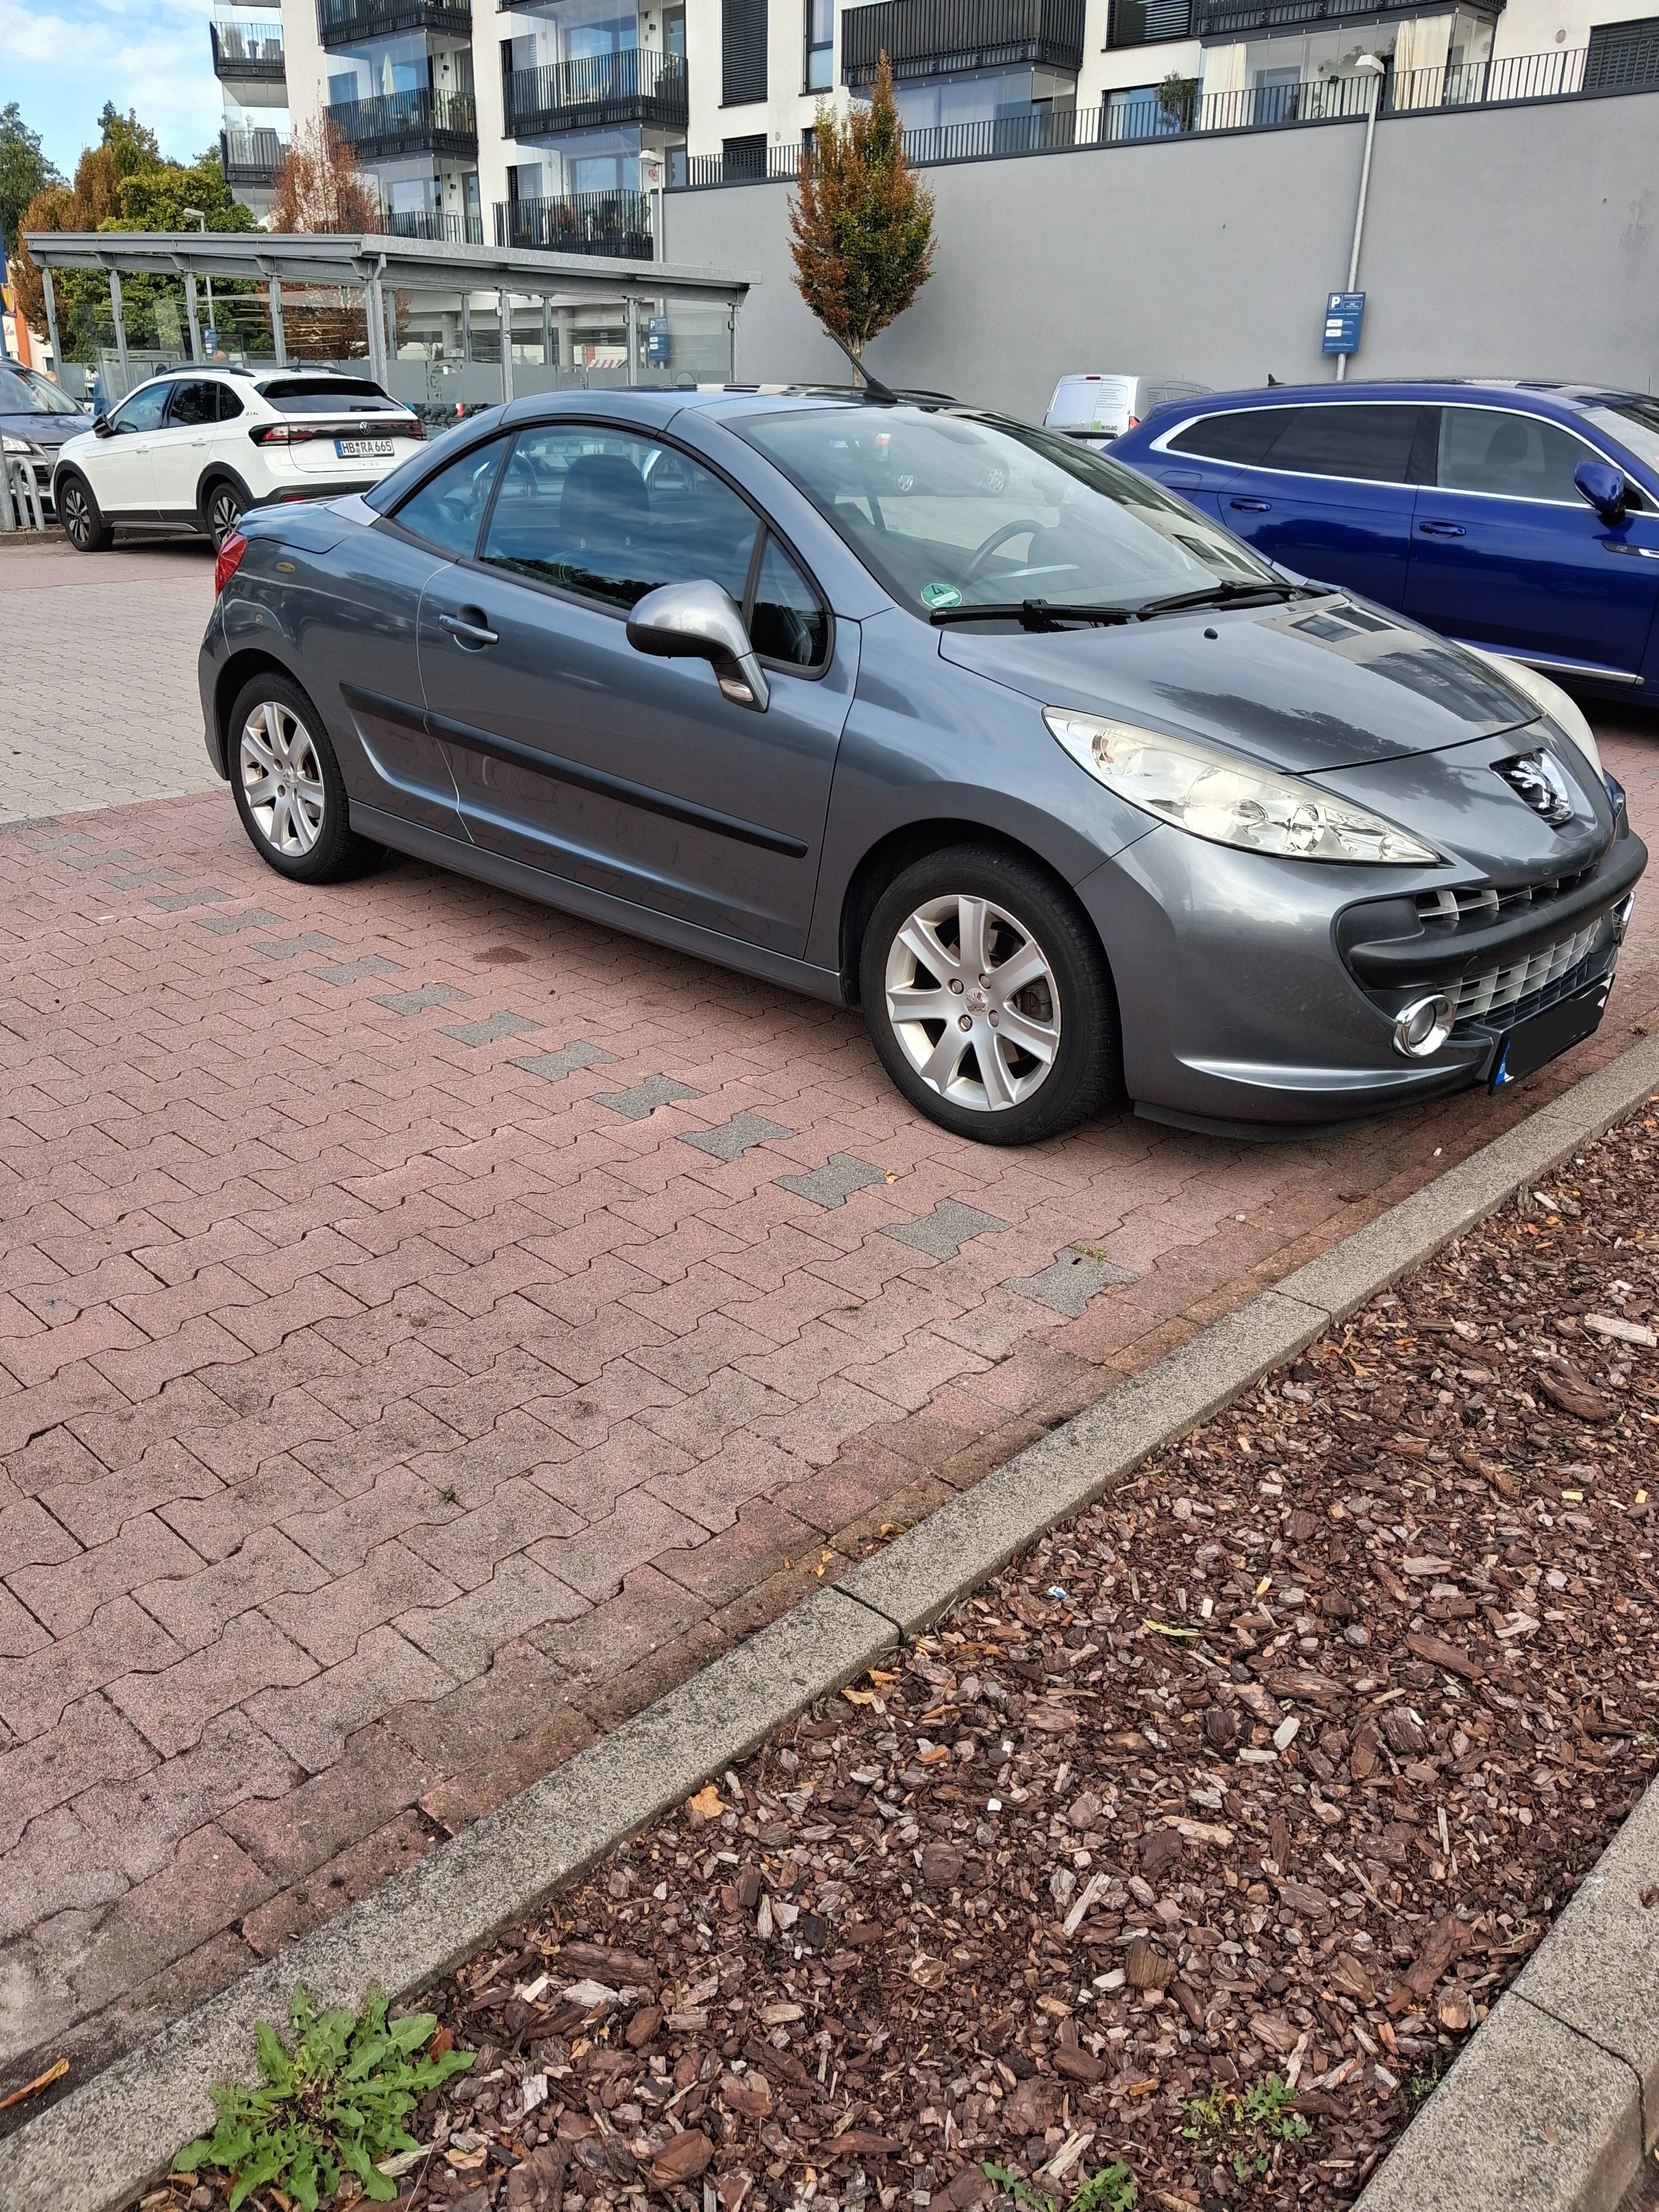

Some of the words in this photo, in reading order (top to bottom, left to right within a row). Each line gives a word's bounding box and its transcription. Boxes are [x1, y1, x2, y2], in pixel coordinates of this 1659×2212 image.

[1331, 296, 1341, 308] P
[651, 320, 655, 329] P
[342, 442, 355, 453] HB
[361, 441, 374, 453] RA
[375, 441, 391, 452] 665
[931, 584, 944, 595] 4
